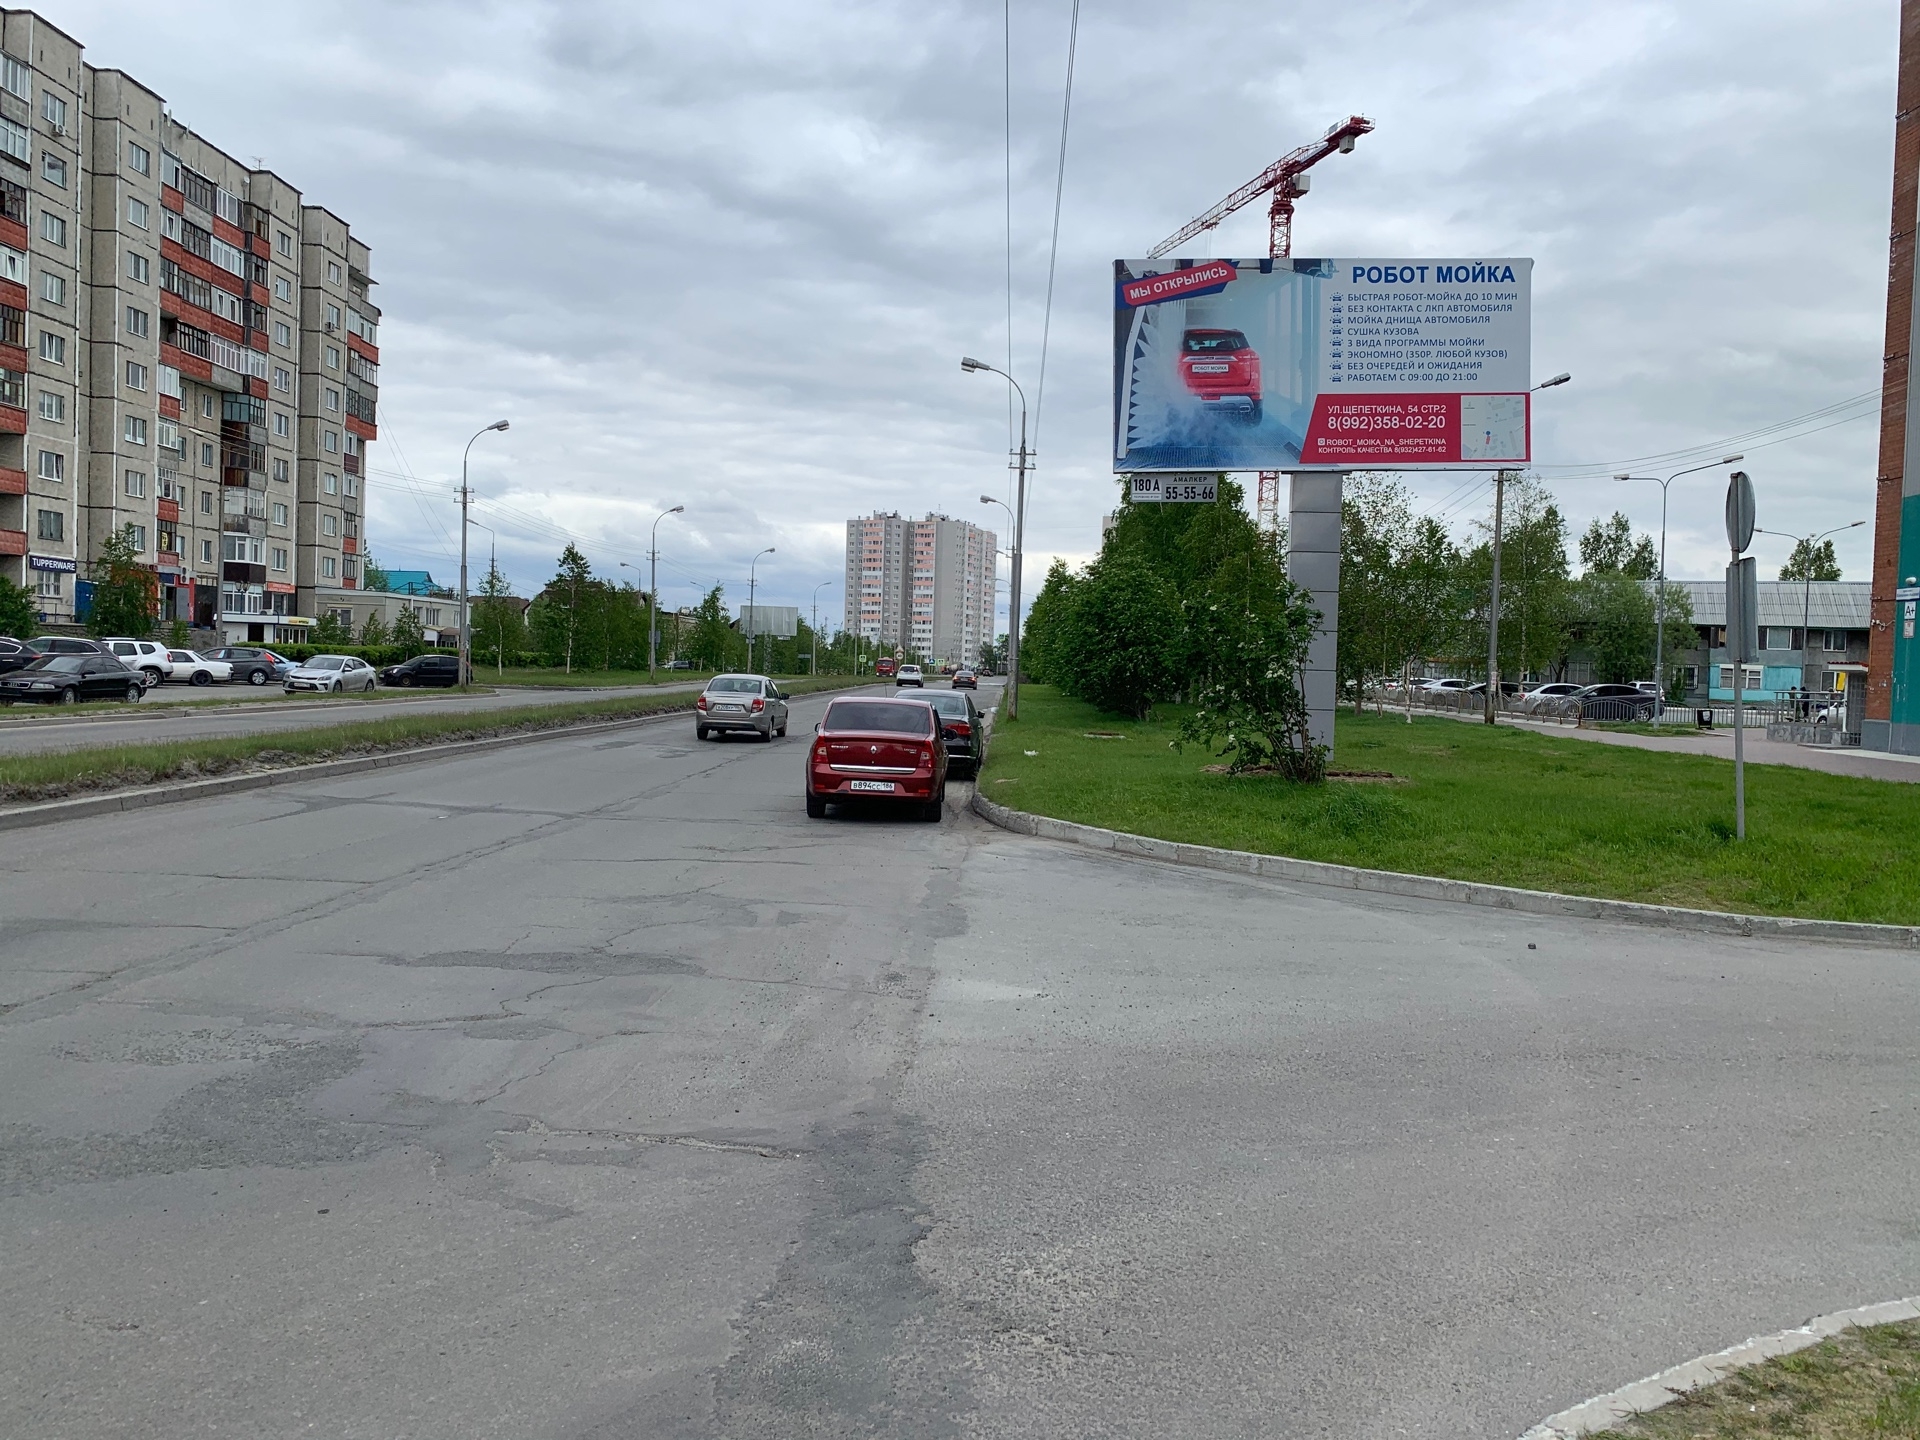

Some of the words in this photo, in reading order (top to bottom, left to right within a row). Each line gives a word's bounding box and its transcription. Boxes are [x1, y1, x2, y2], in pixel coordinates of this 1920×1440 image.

[1353, 266, 1429, 284] РОБОТ
[1436, 262, 1515, 283] МОЙКА
[1130, 286, 1151, 299] МЫ
[1154, 267, 1227, 293] ОТКРЫЛИСЬ
[1348, 293, 1389, 301] БЫСТРАЯ
[1393, 292, 1462, 301] РОБОТ-МОЙКА
[1464, 293, 1479, 302] ДО
[1348, 305, 1364, 313] БЕЗ
[1425, 304, 1444, 312] ЛКП
[1447, 304, 1512, 312] АВТОМОБИЛЯ
[1348, 315, 1382, 324] МОЙКА
[1385, 316, 1422, 325] ДНИЩА
[1424, 316, 1490, 324] АВТОМОБИЛЯ
[1347, 339, 1353, 347] 3
[1356, 339, 1381, 348] ВИДА
[1385, 339, 1446, 347] ПРОГРАММЫ
[1450, 337, 1485, 346] МОЙКИ
[1348, 350, 1403, 359] ЭКОНОМНО
[1406, 350, 1433, 359] (350Р.
[1435, 349, 1472, 358] ЛЮБОЙ
[1474, 350, 1508, 359] КУЗОВ)
[1348, 362, 1364, 370] БЕЗ
[1367, 361, 1415, 370] ОЧЕРЕДЕЙ
[1418, 362, 1424, 370] И
[1428, 362, 1482, 370] ОЖИДАНИЯ
[1348, 374, 1397, 382] РАБОТАЕМ
[1408, 373, 1433, 381] 09:00
[1436, 373, 1450, 382] ДО
[1453, 373, 1478, 381] 21:00
[1328, 405, 1405, 415] УЛ.ЩЕПЕТКИНА,
[1408, 405, 1418, 413] 54
[1421, 405, 1446, 413] СТР.2
[1328, 416, 1446, 432] 8(992)358-02-20
[1327, 438, 1446, 447] ROBOT_MOIKA_NA_SHEPETKINA
[1134, 479, 1151, 491] 180
[1166, 486, 1214, 500] 55-55-66
[32, 558, 75, 570] TUPPERWARE
